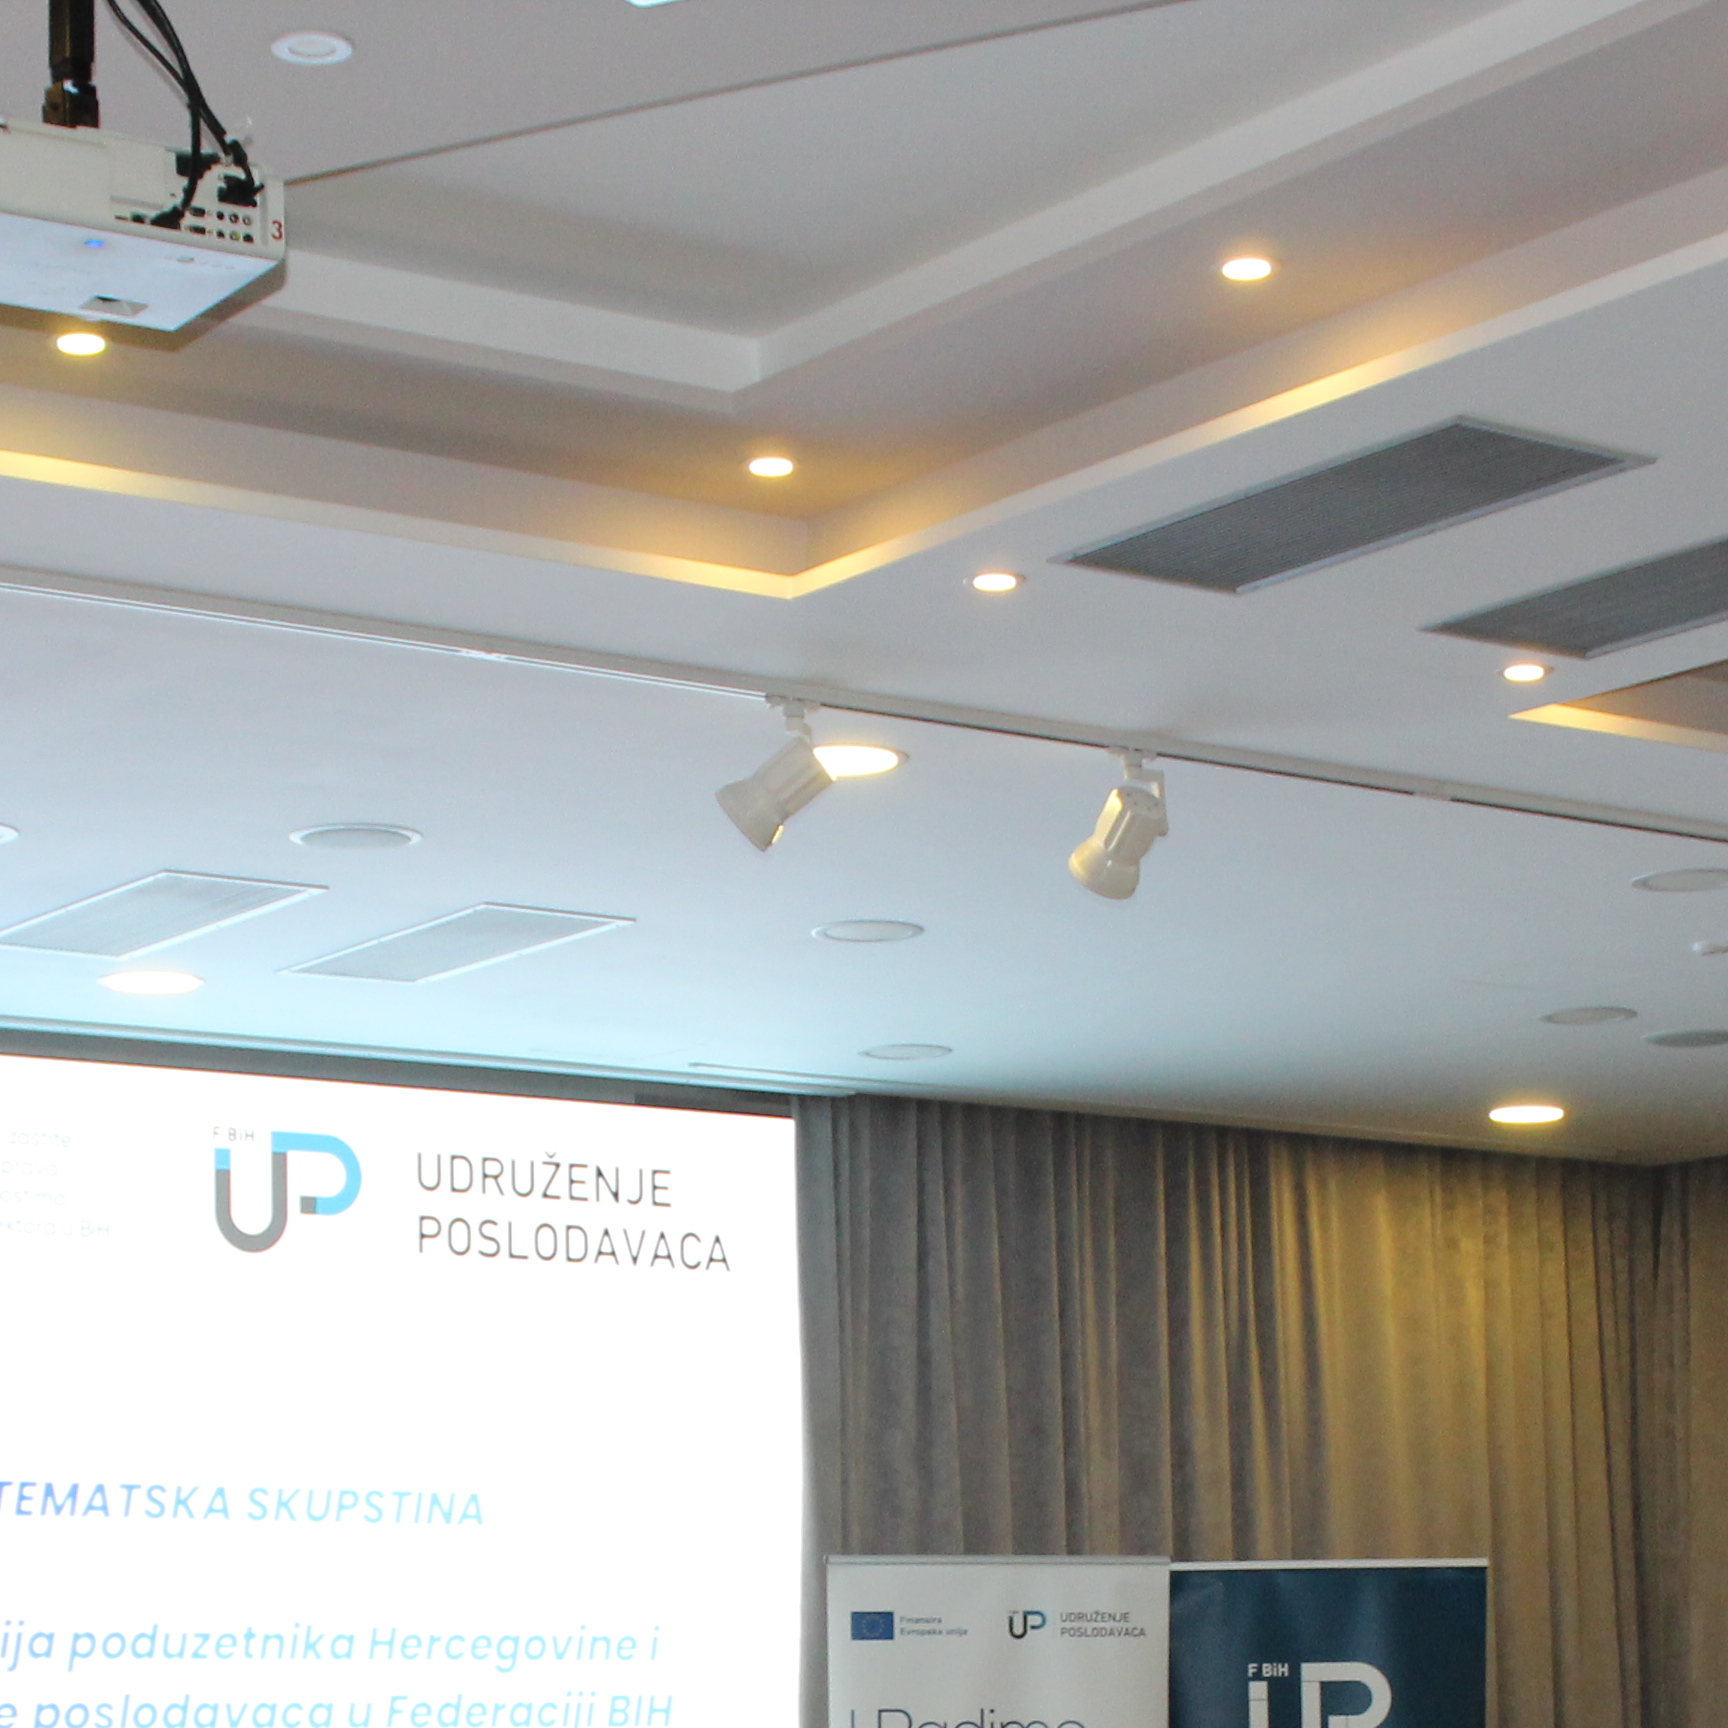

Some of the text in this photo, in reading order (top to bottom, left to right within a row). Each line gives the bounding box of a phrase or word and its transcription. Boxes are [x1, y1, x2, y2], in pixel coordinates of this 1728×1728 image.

[271, 220, 283, 241] 3
[228, 1127, 254, 1141] BiH
[418, 1152, 671, 1207] UDRUŽENJE
[419, 1215, 730, 1271] POSLODAVACA
[247, 1487, 482, 1525] SKUPSTINA
[1060, 1610, 1130, 1623] UDRUŽENJE
[1060, 1626, 1147, 1639] POSLODAVACA
[69, 1622, 355, 1673] poduzetnika
[369, 1624, 637, 1673] Hercegovine
[651, 1625, 660, 1660] i
[1247, 1663, 1290, 1678] F BiH
[348, 1703, 372, 1728] u
[608, 1695, 673, 1727] BIH
